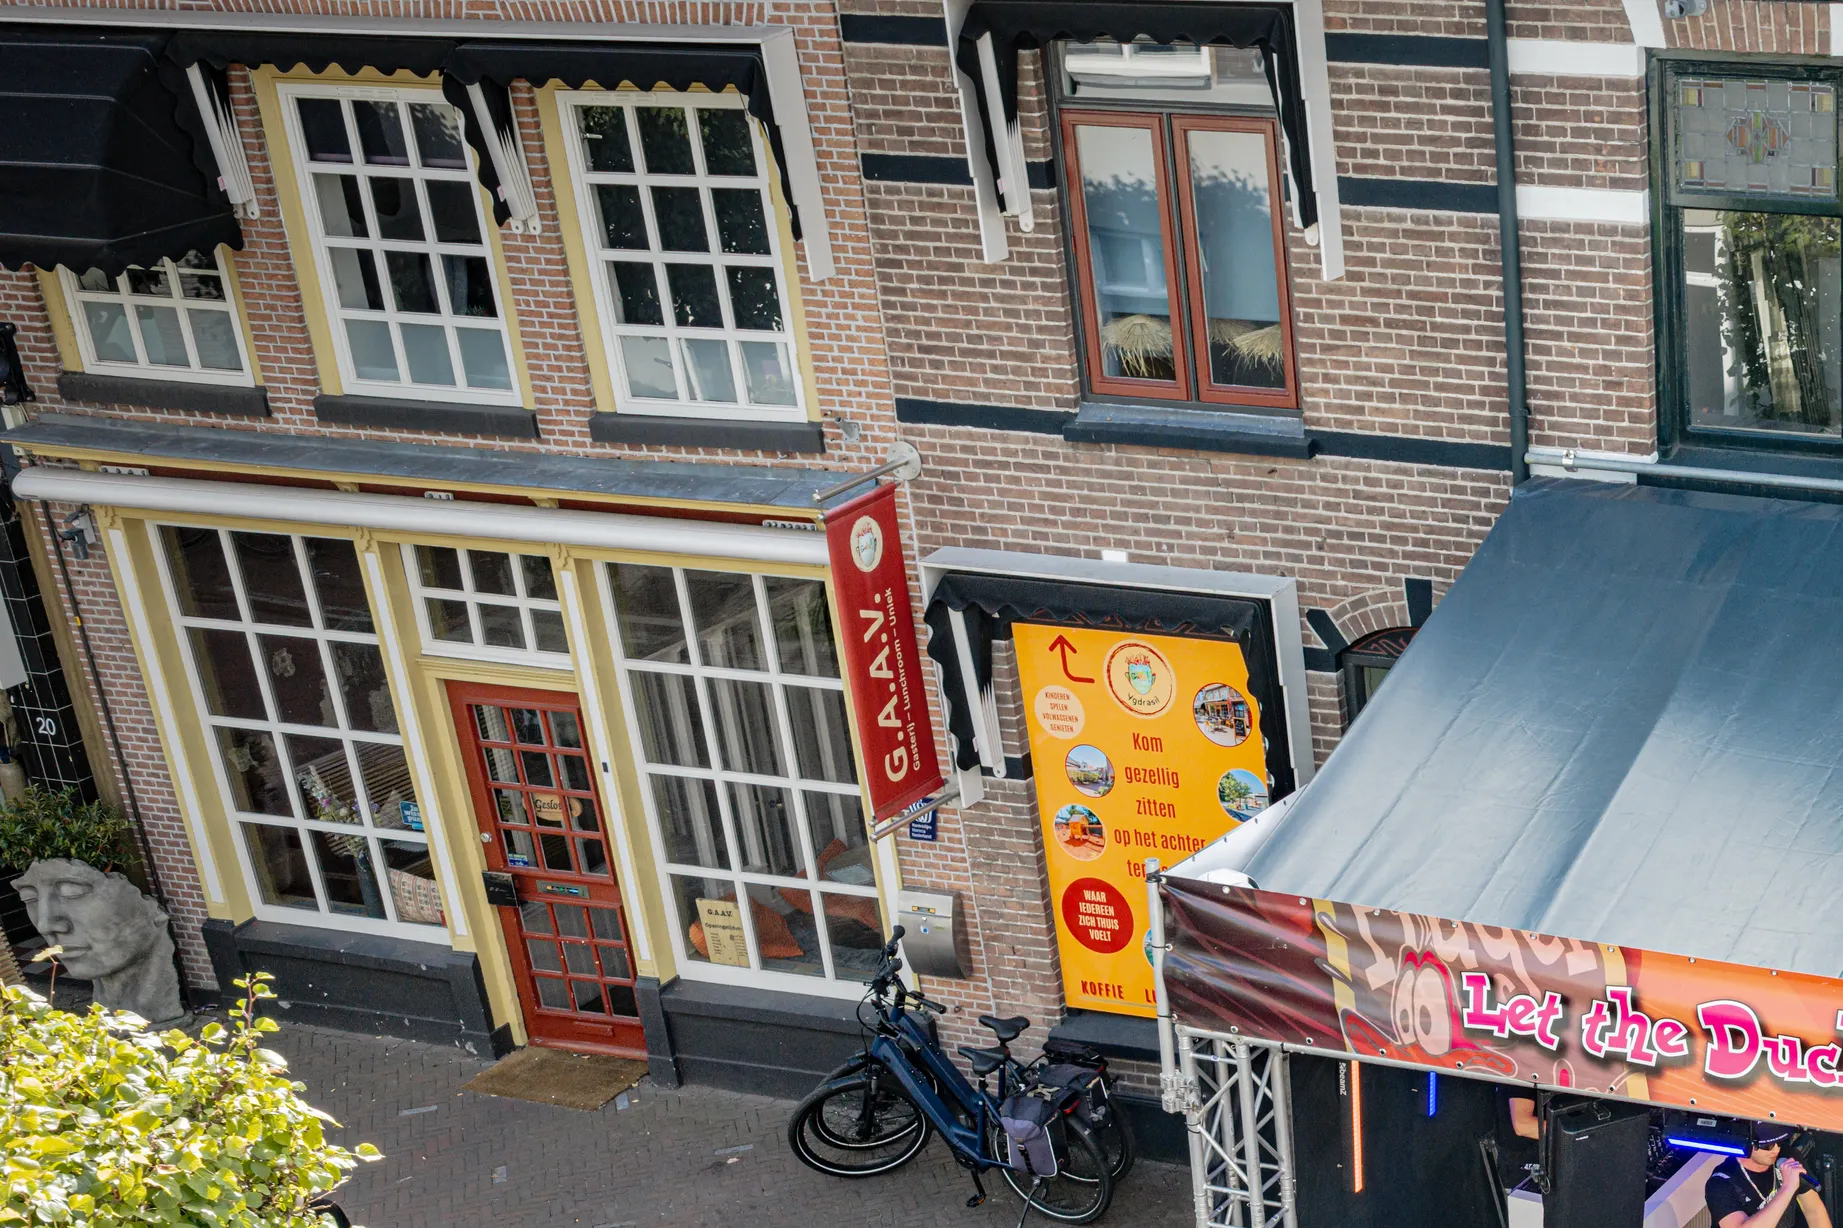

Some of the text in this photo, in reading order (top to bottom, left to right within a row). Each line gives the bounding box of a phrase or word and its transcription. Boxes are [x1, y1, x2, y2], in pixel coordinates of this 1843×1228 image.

[860, 593, 908, 782] G.A.A.V.
[884, 587, 921, 771] Gasterij Lunchroom Uniek
[1045, 692, 1070, 700] KINDEREN
[1050, 702, 1068, 711] SPELEN
[36, 717, 56, 735] 20
[1042, 712, 1079, 722] VOLWASSENEN
[1132, 732, 1163, 752] Kom
[1125, 765, 1180, 789] gezellig
[535, 799, 564, 812] Geslo
[1136, 799, 1176, 818] zitten
[1114, 829, 1206, 852] op het achter
[1083, 890, 1107, 903] WAAR
[1079, 902, 1115, 917] IEDEREEN
[1078, 915, 1119, 930] ZICH THUIS
[1089, 929, 1111, 942] VOELT
[1081, 980, 1125, 1000] KOFFIE
[1460, 971, 1563, 1050] Let
[1581, 985, 1688, 1067] the
